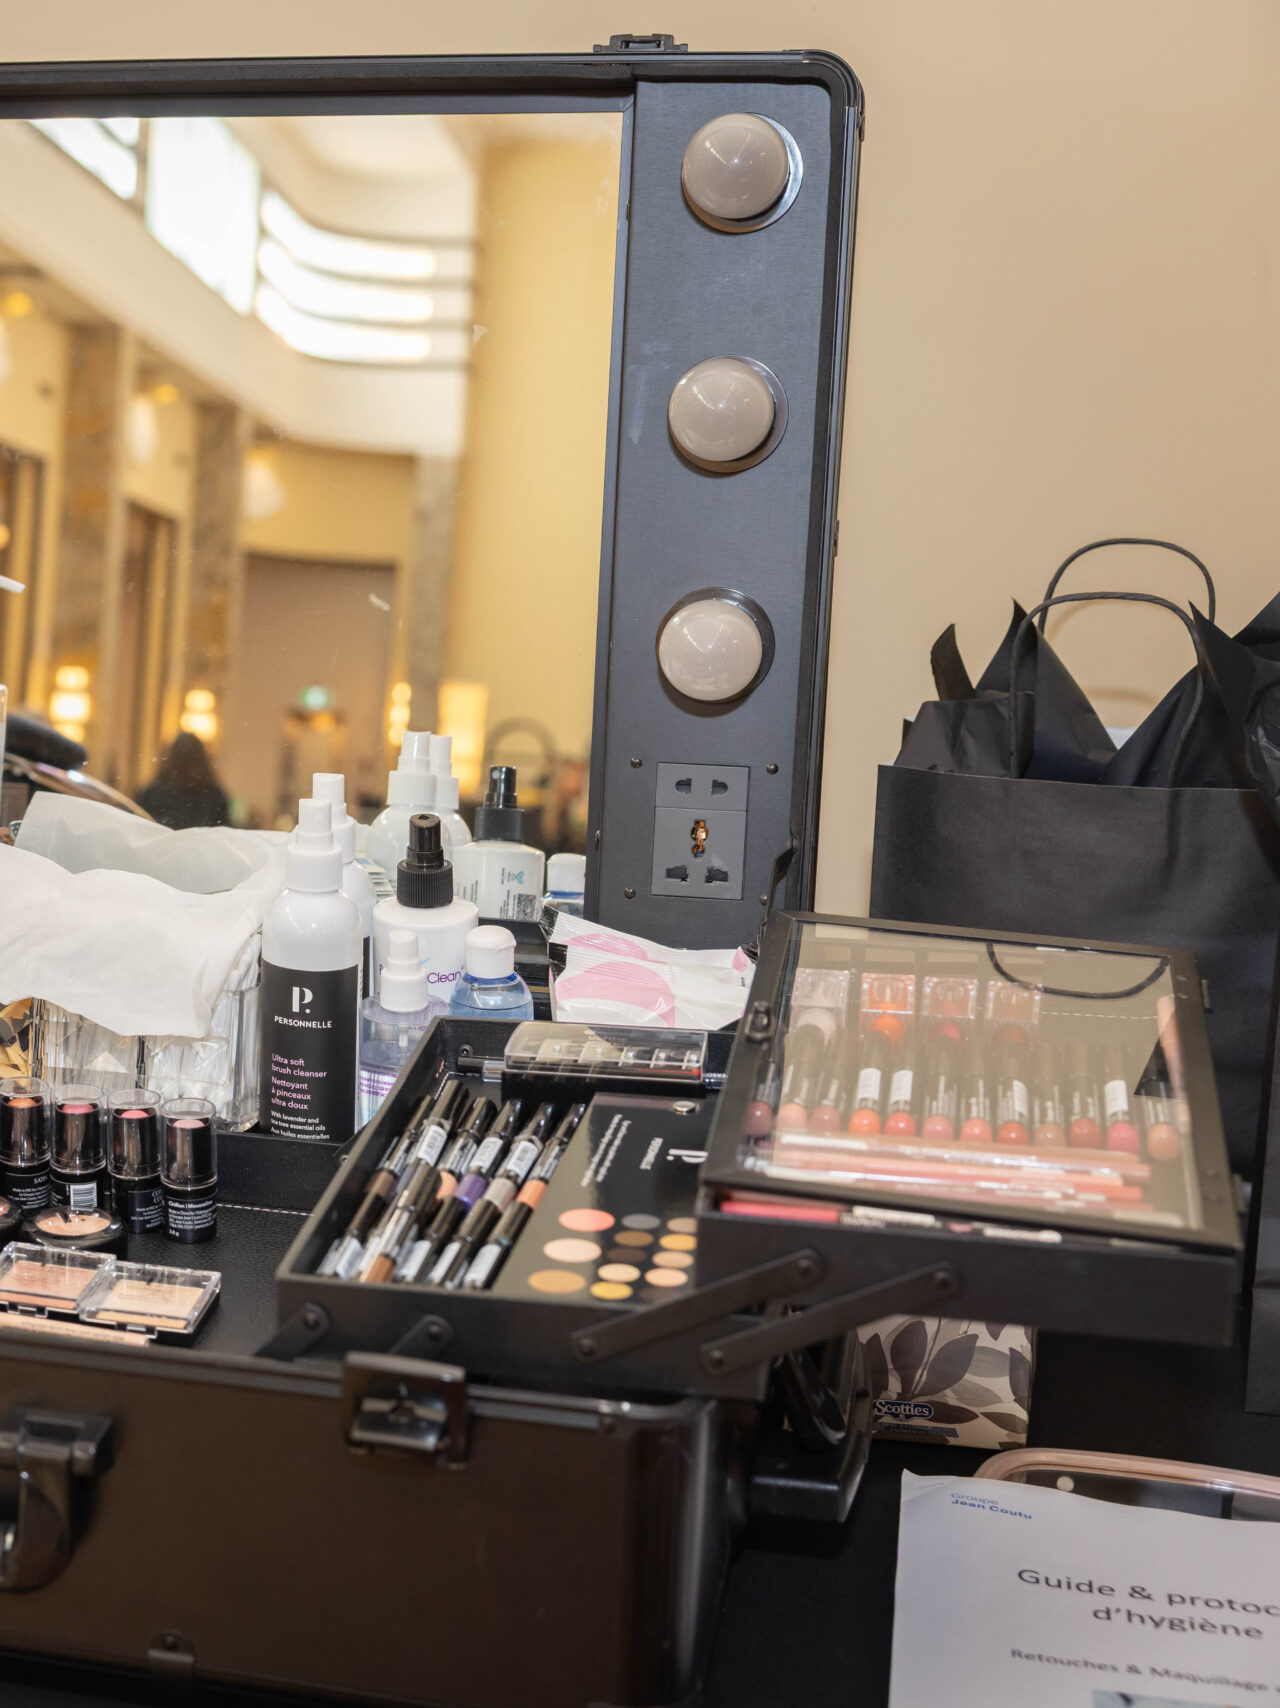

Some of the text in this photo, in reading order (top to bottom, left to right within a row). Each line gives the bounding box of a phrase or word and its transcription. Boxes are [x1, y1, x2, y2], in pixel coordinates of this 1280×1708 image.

[427, 971, 462, 984] Clean
[292, 986, 313, 1014] P.
[274, 1015, 333, 1029] PERSONNELLE
[272, 1053, 305, 1067] Ultra soft
[271, 1062, 327, 1078] brush cleanser
[271, 1076, 308, 1090] Nettoyant
[276, 1088, 312, 1101] pinceaux
[271, 1097, 308, 1110] ultra doux
[282, 1113, 307, 1123] lavender
[290, 1122, 314, 1131] essential
[280, 1128, 296, 1138] huiles
[297, 1132, 330, 1140] essentielles
[874, 1400, 930, 1416] Scotties
[950, 1492, 999, 1505] Groupe
[951, 1499, 1033, 1520] Jean Coutu
[1017, 1568, 1116, 1597] Guide
[1128, 1584, 1155, 1602] &
[1010, 1649, 1269, 1693] Retouches & Maquillage
